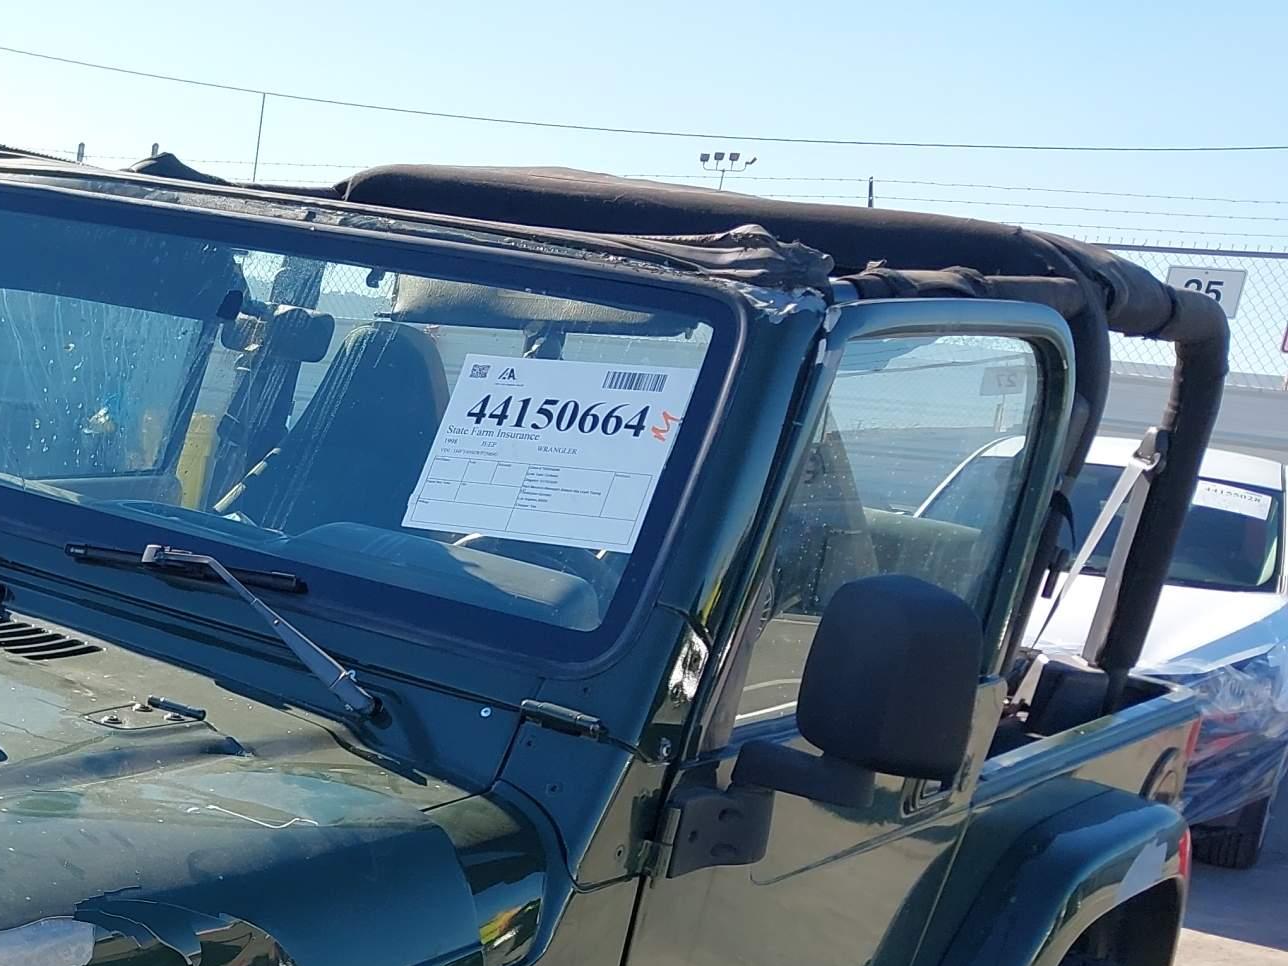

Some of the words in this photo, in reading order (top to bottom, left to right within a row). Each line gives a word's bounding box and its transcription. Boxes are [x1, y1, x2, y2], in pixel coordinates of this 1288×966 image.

[467, 394, 650, 437] 44150664
[447, 424, 469, 435] State
[471, 427, 495, 438] Farm
[496, 429, 541, 441] Insurance
[536, 445, 579, 456] WRANGLER
